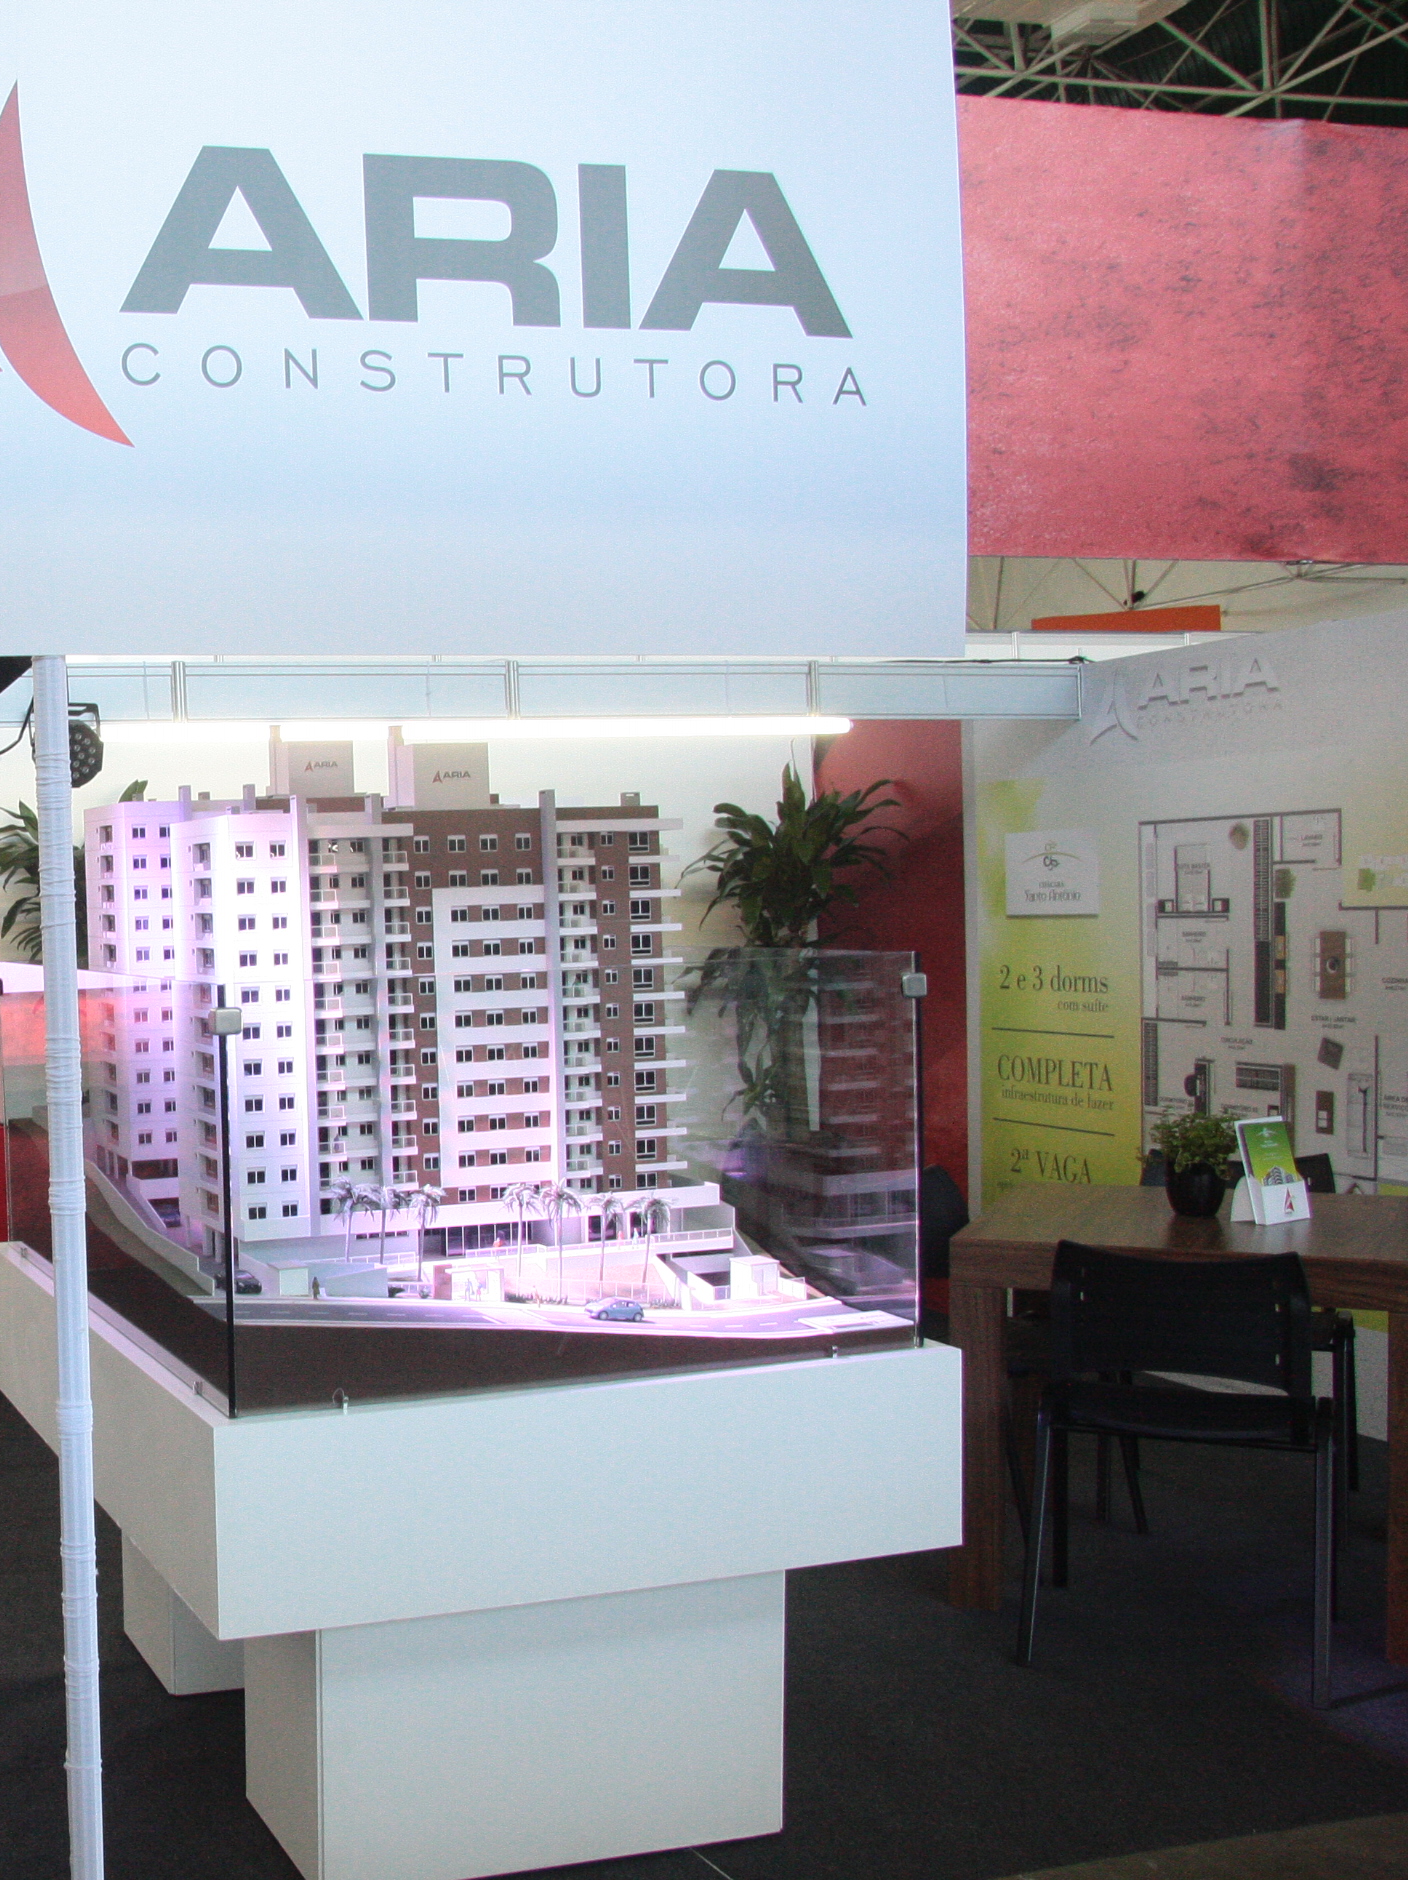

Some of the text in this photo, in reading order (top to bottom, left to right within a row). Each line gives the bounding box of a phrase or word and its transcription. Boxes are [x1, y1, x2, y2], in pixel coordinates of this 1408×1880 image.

[119, 144, 854, 340] ARIA
[120, 342, 868, 407] CONSTRUTORA
[1137, 655, 1281, 711] ARIA
[443, 770, 471, 779] ARIA
[999, 964, 1109, 993] 2 e 3 dorms
[1057, 1001, 1079, 1011] com
[997, 1053, 1113, 1092] COMPLETA
[1001, 1084, 1068, 1106] infraestrutura
[1070, 1092, 1084, 1107] de
[1035, 1150, 1092, 1185] VAGA
